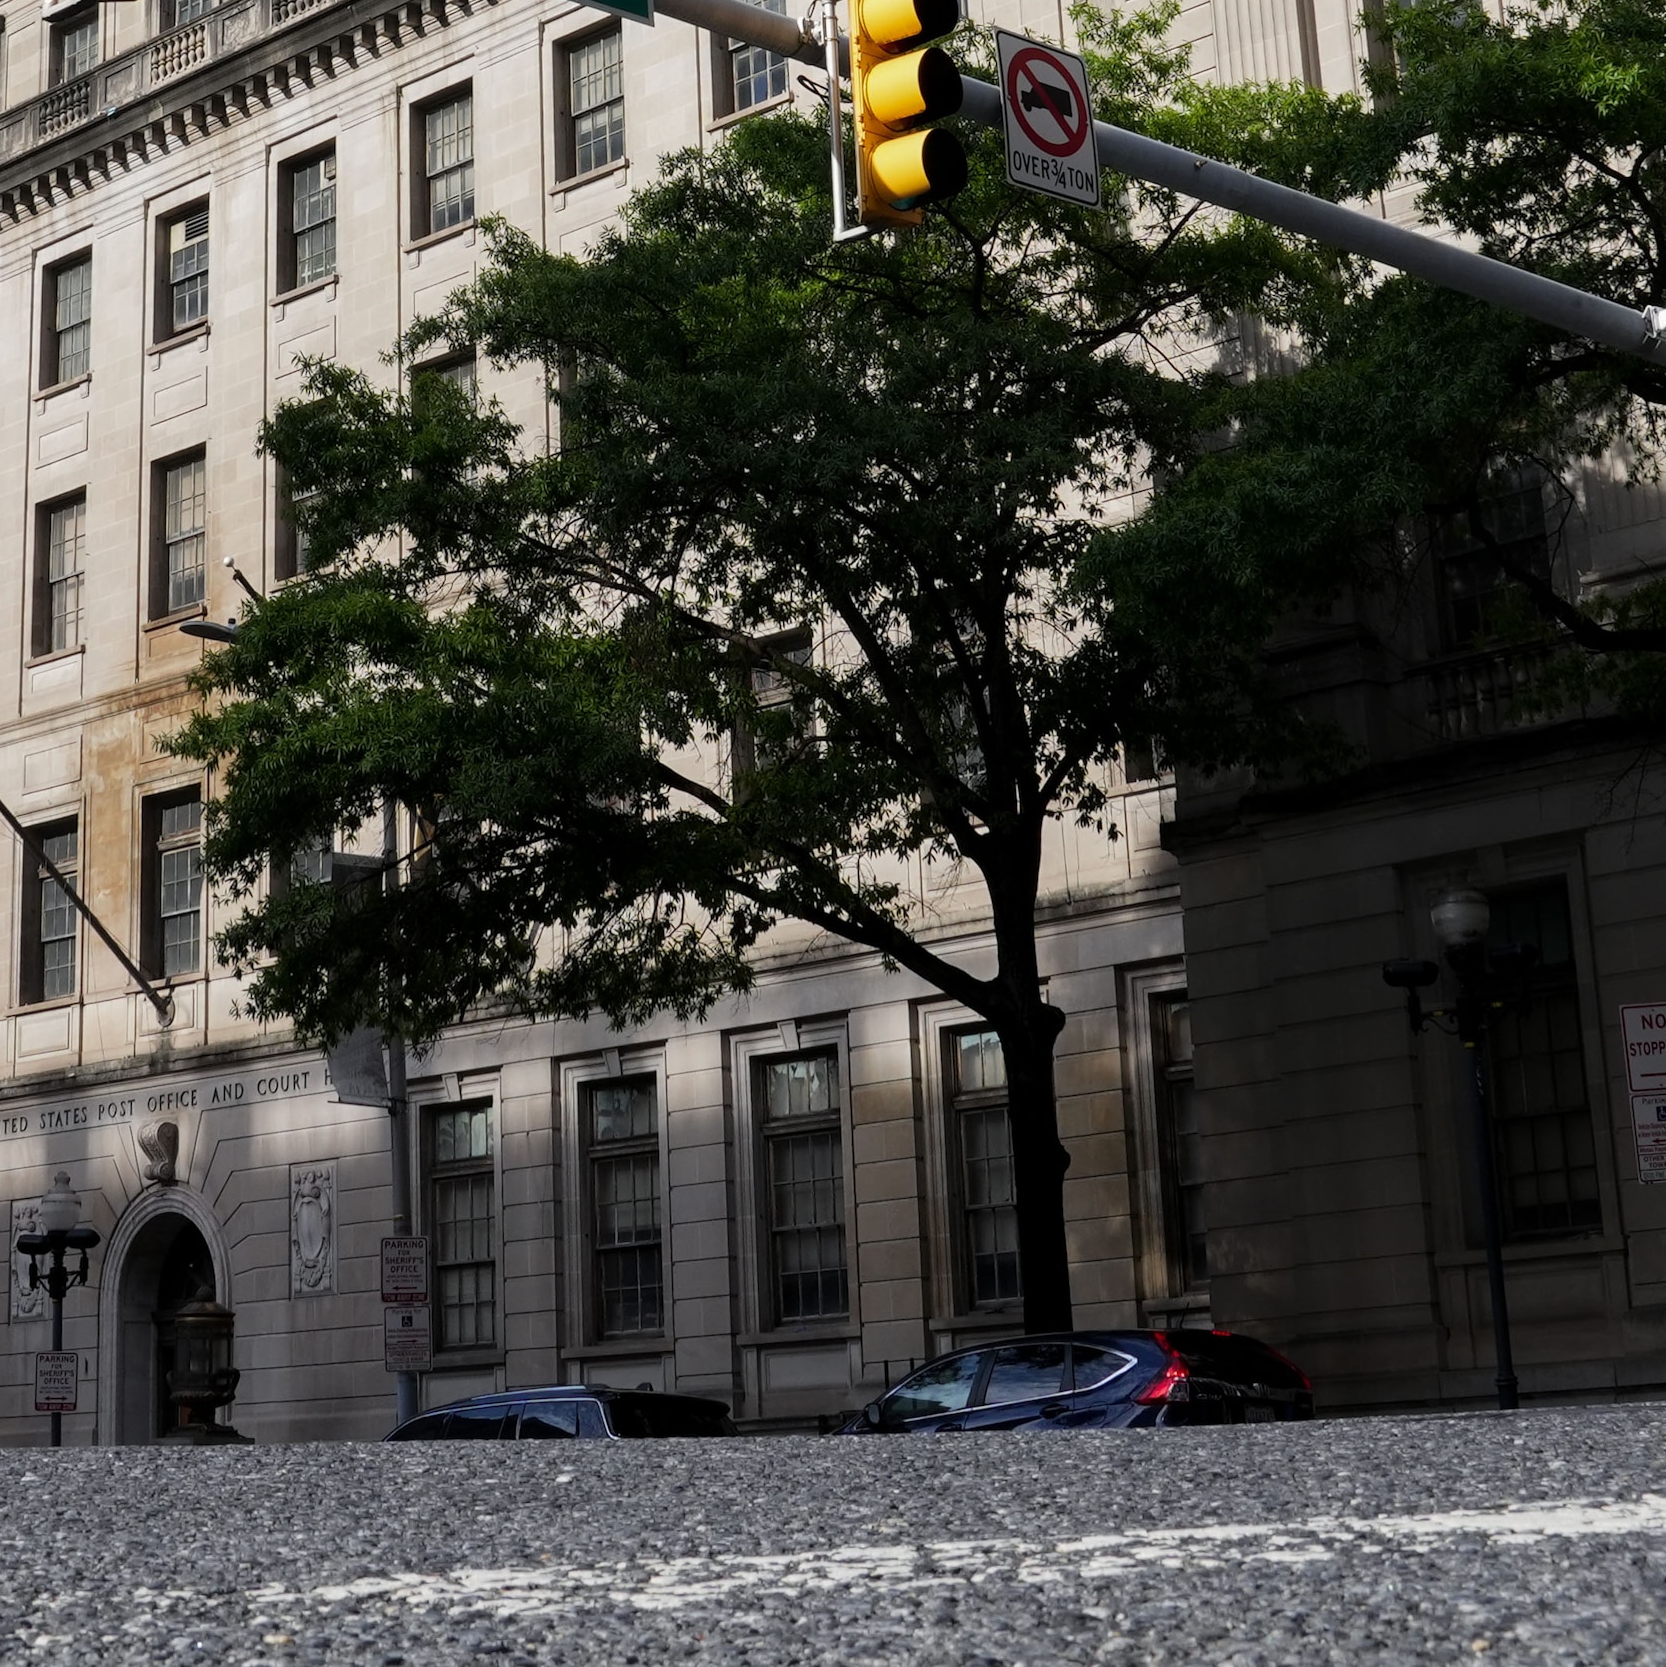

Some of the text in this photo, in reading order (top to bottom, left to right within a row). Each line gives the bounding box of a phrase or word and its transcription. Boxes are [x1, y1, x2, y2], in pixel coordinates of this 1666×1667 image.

[1013, 150, 1051, 180] OVER
[1067, 166, 1094, 194] TON
[1641, 1013, 1666, 1030] NO
[39, 1107, 88, 1129] STATES
[97, 1098, 135, 1121] POST
[147, 1089, 198, 1113] OFFICE
[211, 1083, 244, 1104] AND
[257, 1072, 310, 1096] COURT
[384, 1240, 424, 1249] PARKING
[385, 1256, 424, 1264] SHERIFF'S
[390, 1265, 419, 1273] OFFICE
[39, 1355, 75, 1363] PARKING
[39, 1369, 74, 1377] SHERIFF'S
[43, 1377, 69, 1385] OFFICE
